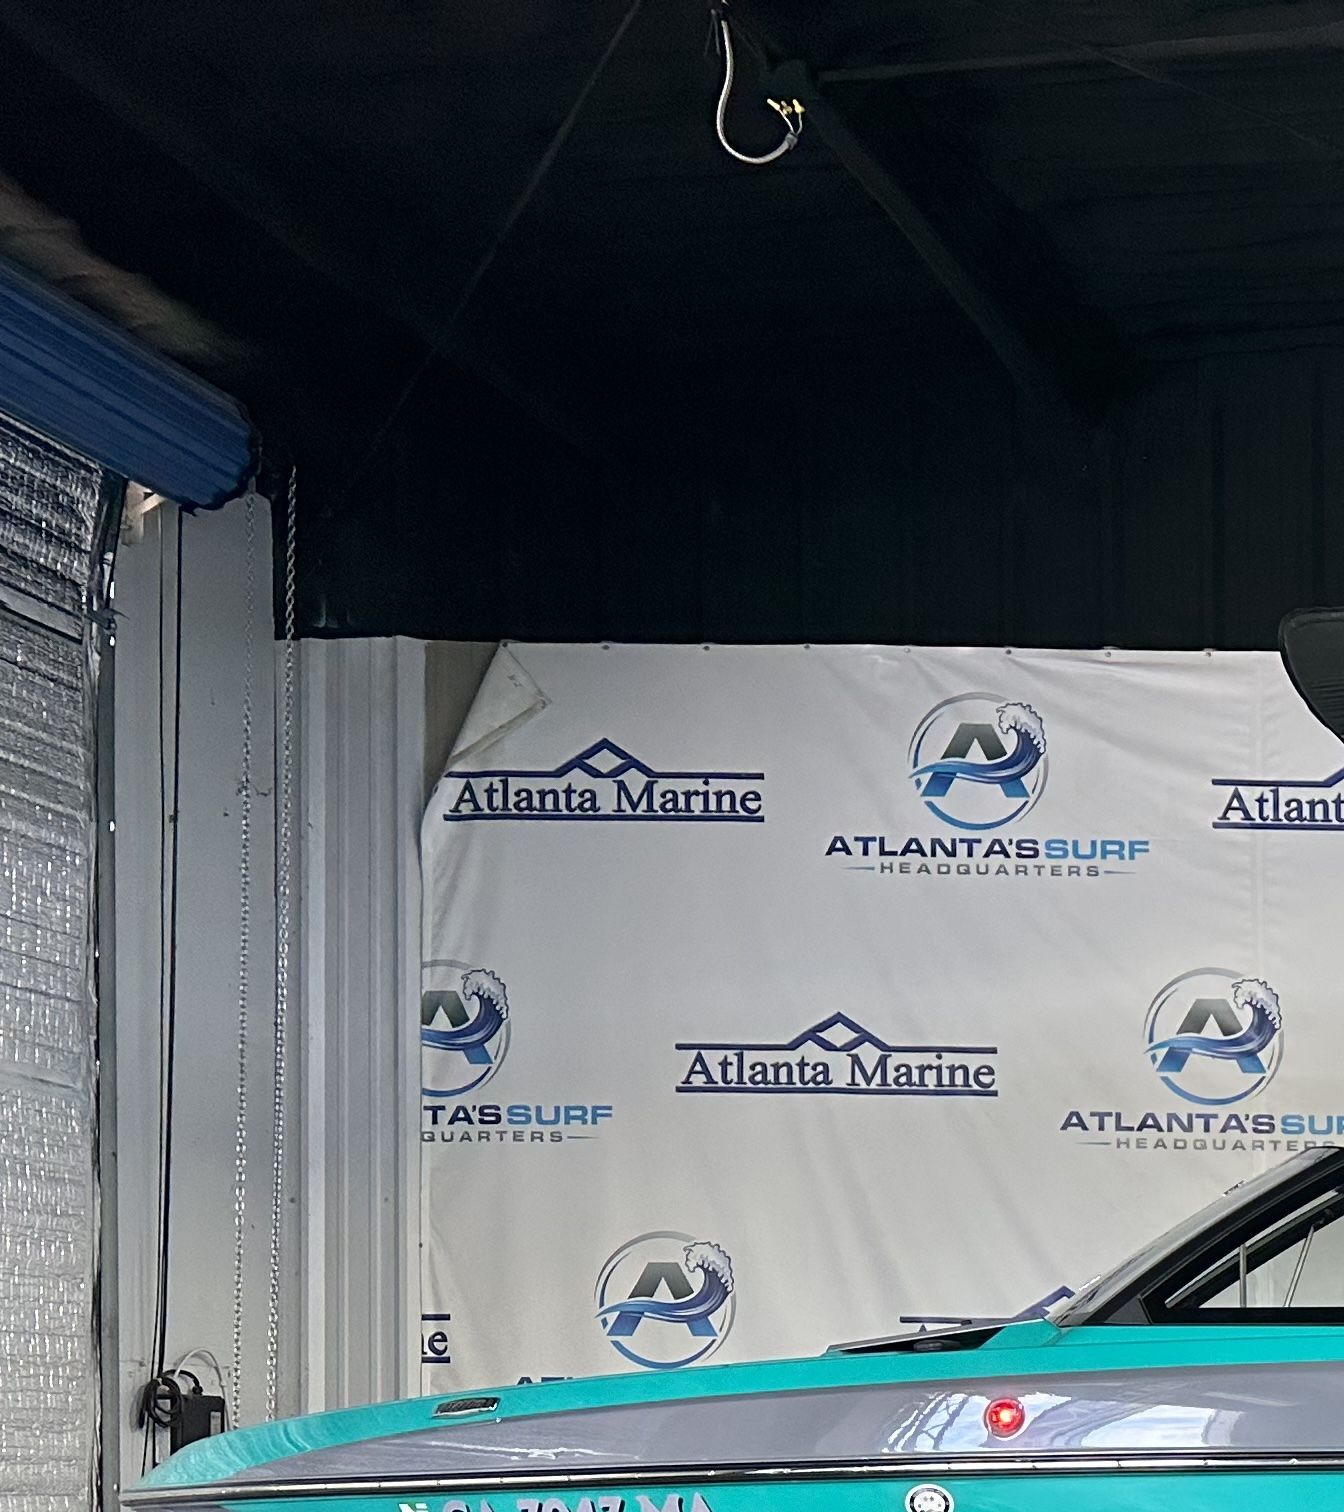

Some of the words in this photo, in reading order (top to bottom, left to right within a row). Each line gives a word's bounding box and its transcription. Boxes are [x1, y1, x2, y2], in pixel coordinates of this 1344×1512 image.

[449, 779, 600, 813] Atlanta
[612, 779, 762, 815] Marine
[824, 836, 1039, 859] ATLANTA'S
[1045, 839, 1149, 860] SURF
[880, 862, 1100, 877] HEADQUARTERS
[682, 1051, 833, 1086] Atlanta
[849, 1052, 995, 1089] Marine
[507, 1105, 612, 1125] SURF
[1060, 1111, 1275, 1134] ATLANTA'S
[422, 1130, 563, 1143] QUARTERS
